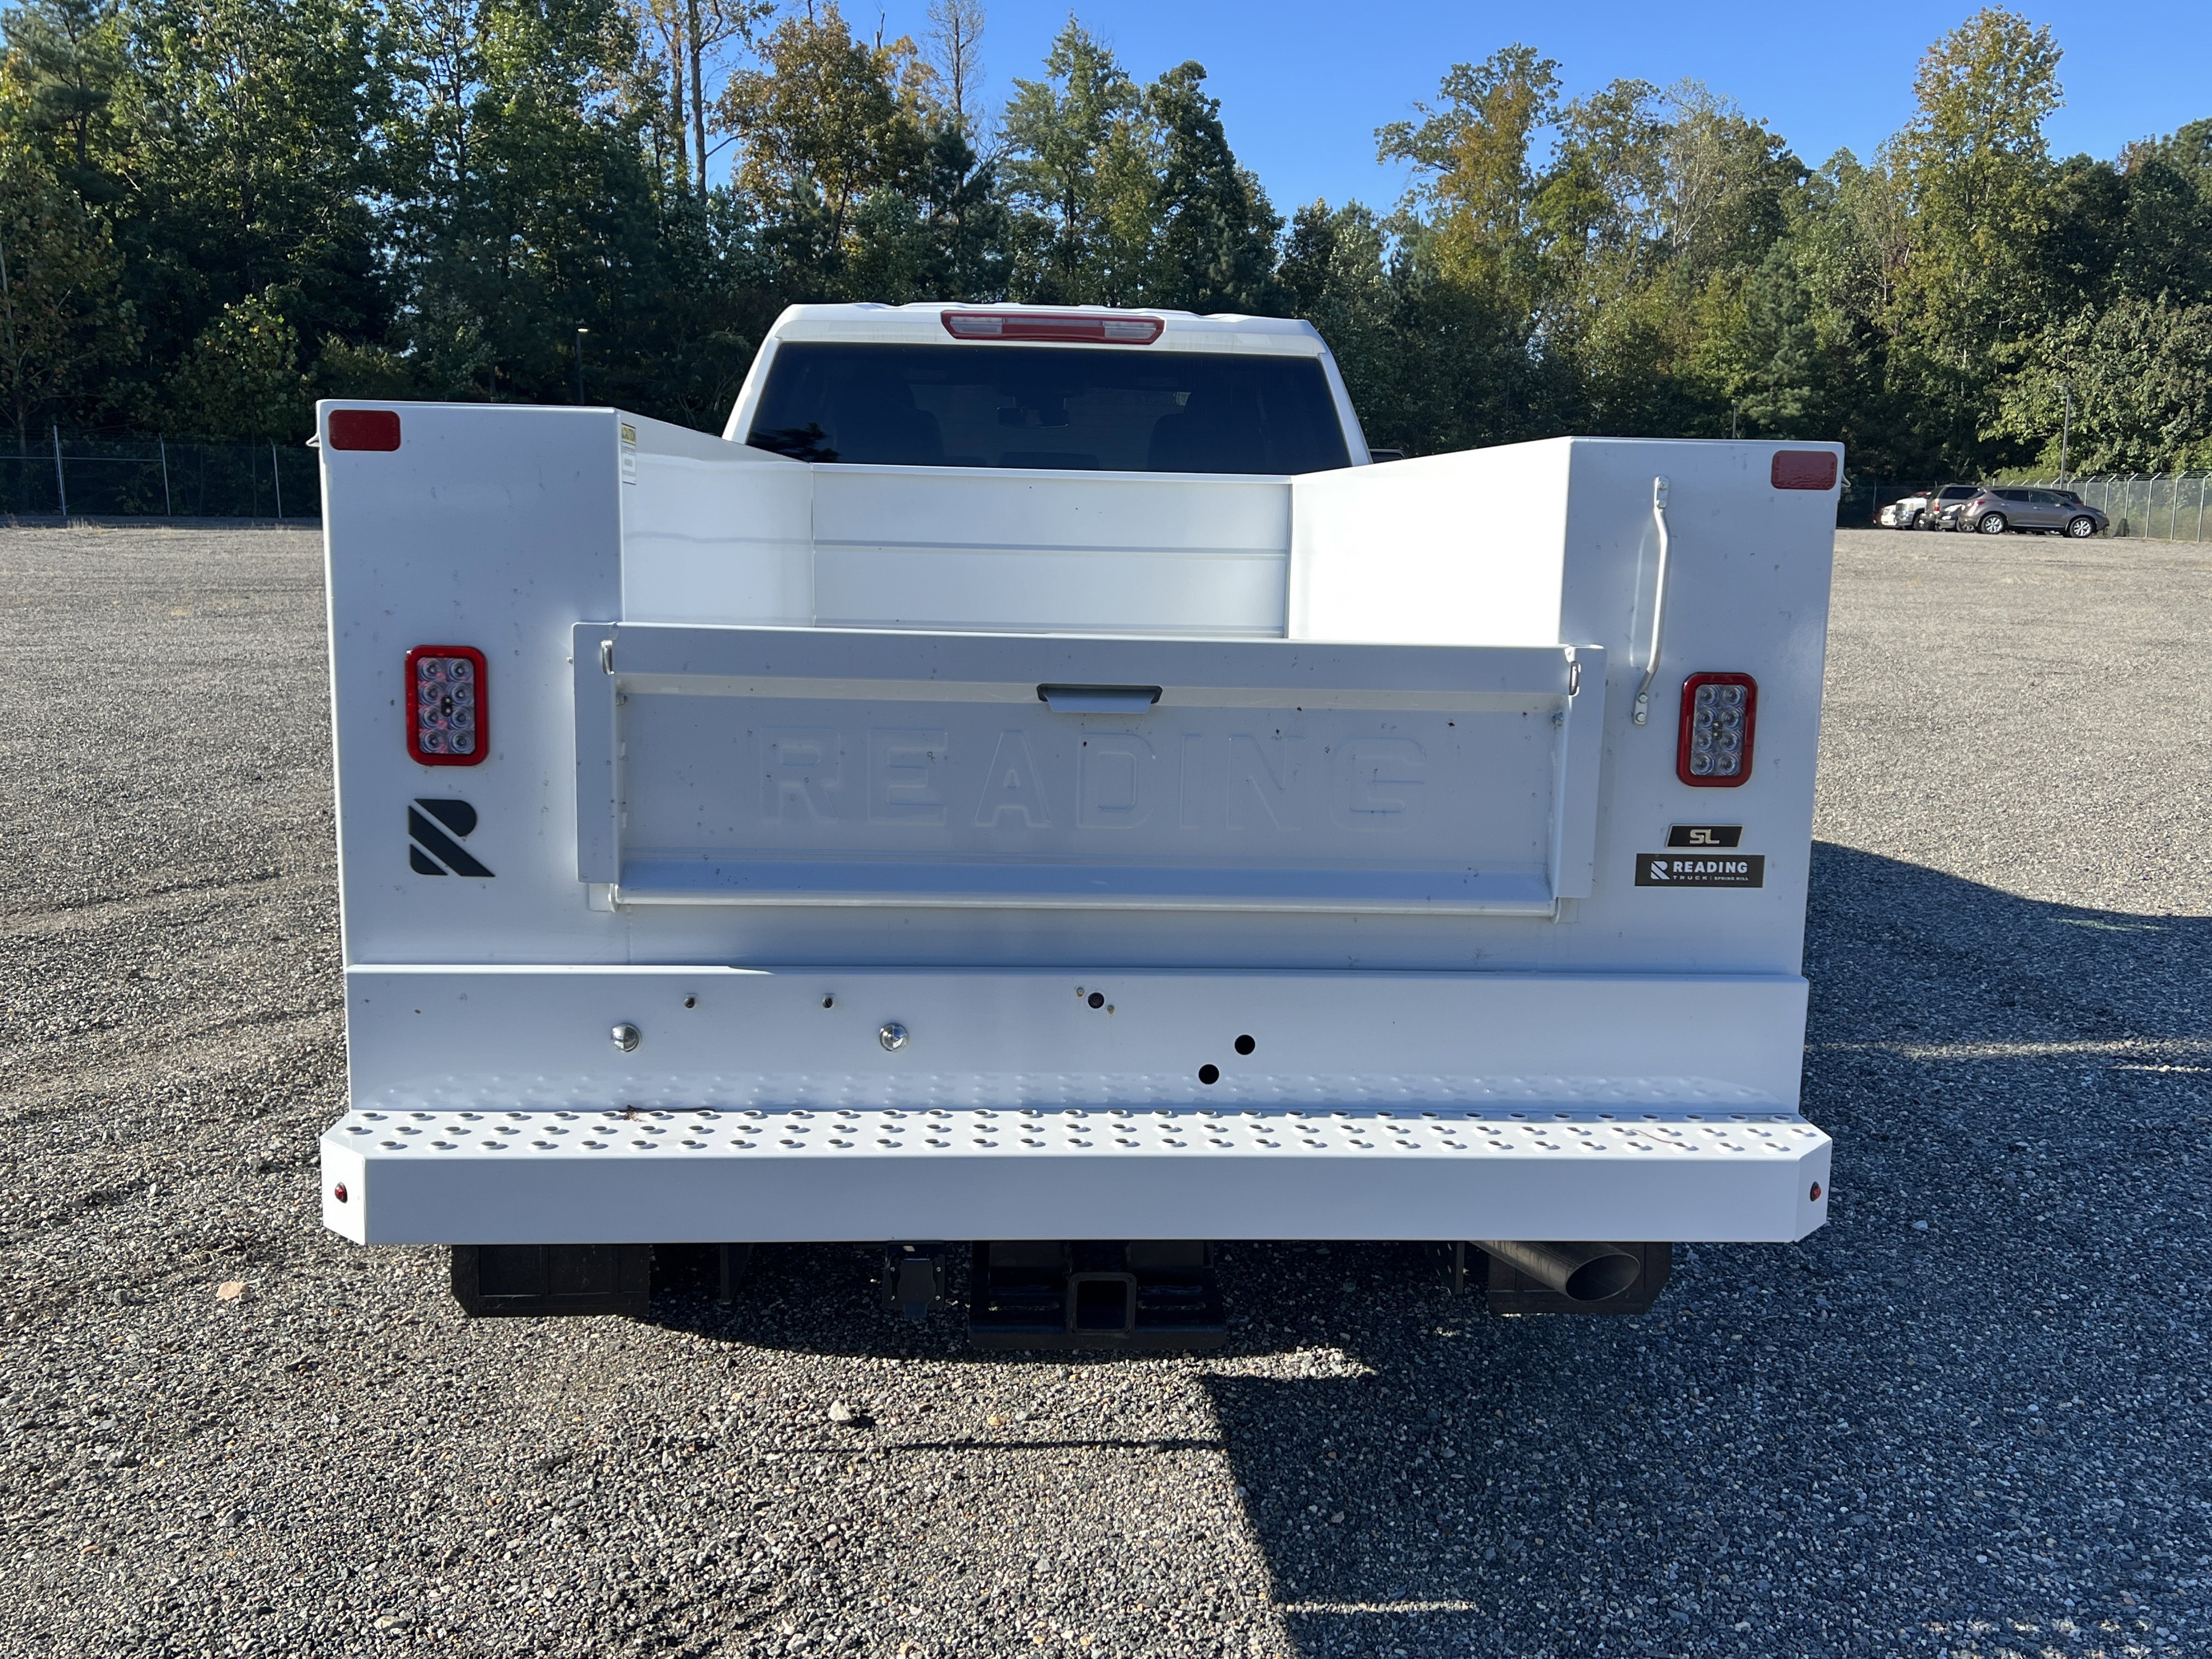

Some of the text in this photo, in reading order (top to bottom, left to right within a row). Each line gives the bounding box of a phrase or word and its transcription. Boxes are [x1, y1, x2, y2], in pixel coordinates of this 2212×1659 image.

[758, 725, 1427, 833] READING
[1689, 828, 1720, 844] SL
[1673, 861, 1748, 873] READING
